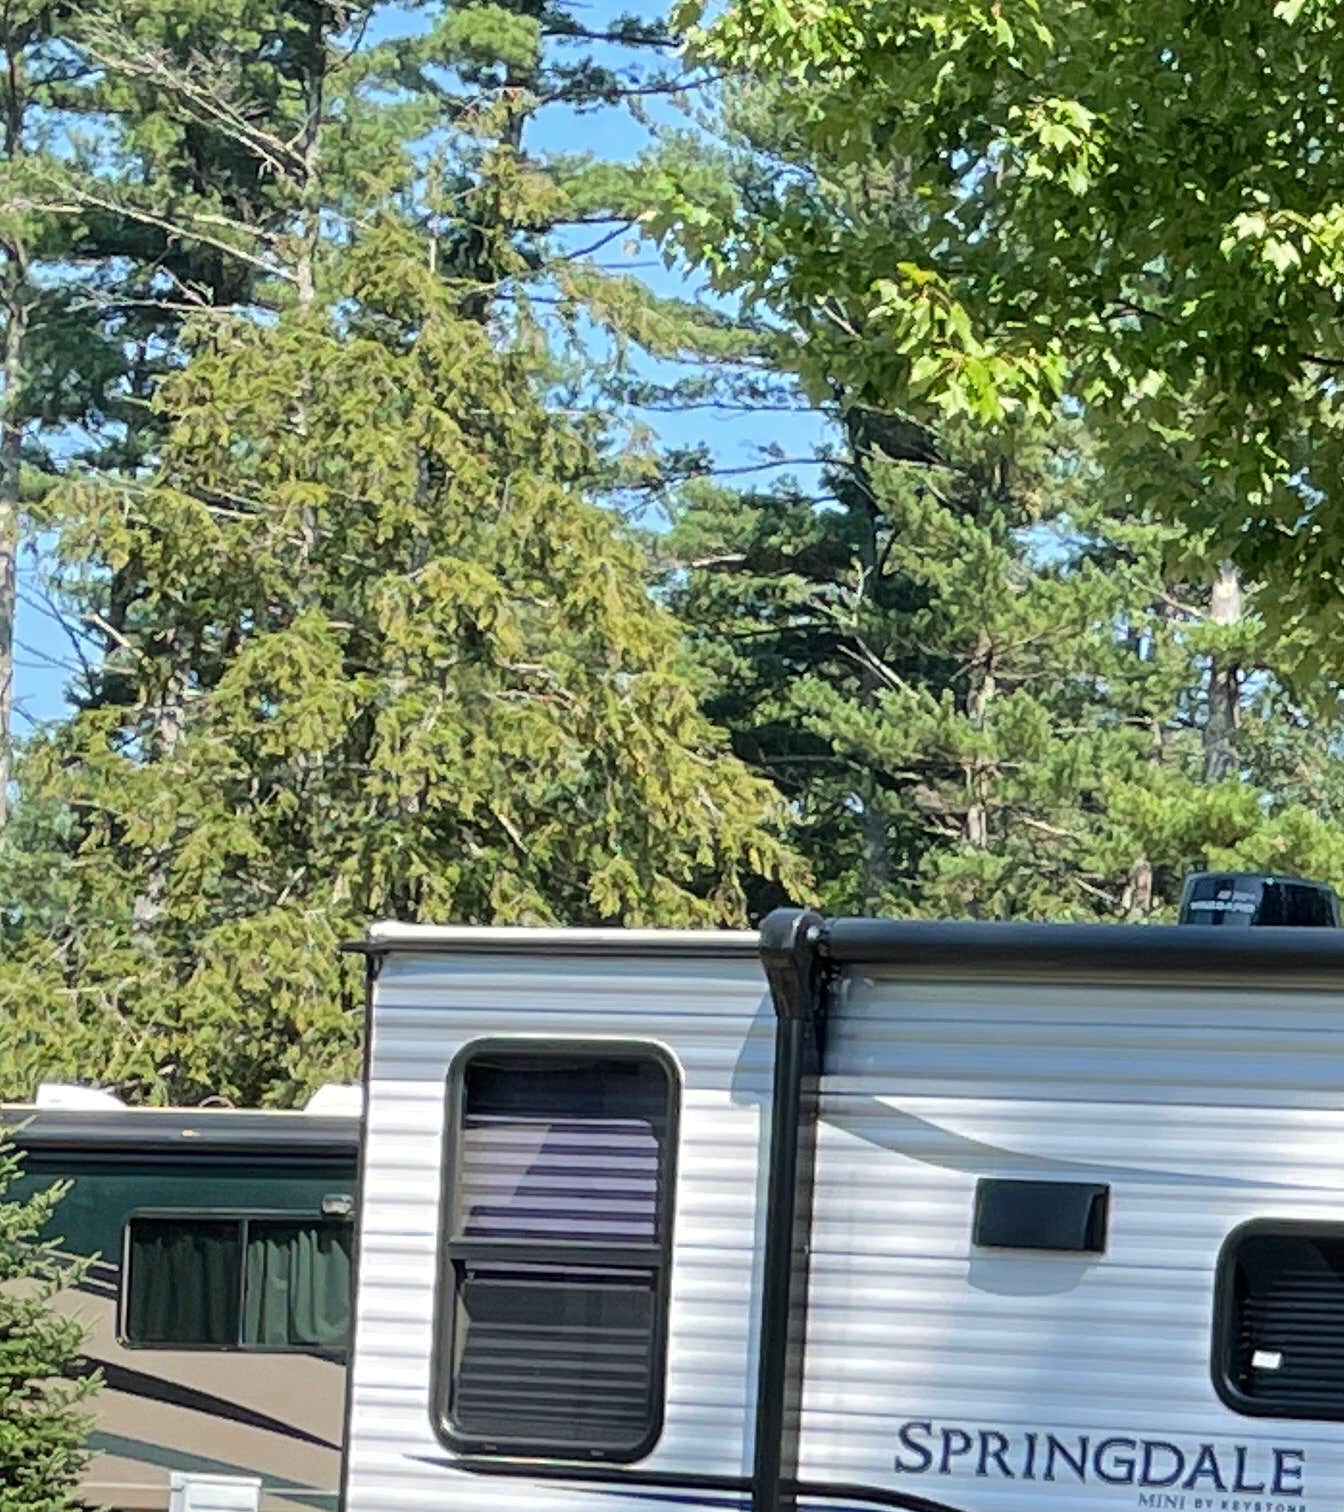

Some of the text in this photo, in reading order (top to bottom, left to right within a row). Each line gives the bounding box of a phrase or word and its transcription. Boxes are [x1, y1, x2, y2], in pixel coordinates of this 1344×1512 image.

[895, 1419, 1305, 1497] SPRINGDALE
[1138, 1492, 1186, 1510] MINI
[1194, 1498, 1213, 1510] BY
